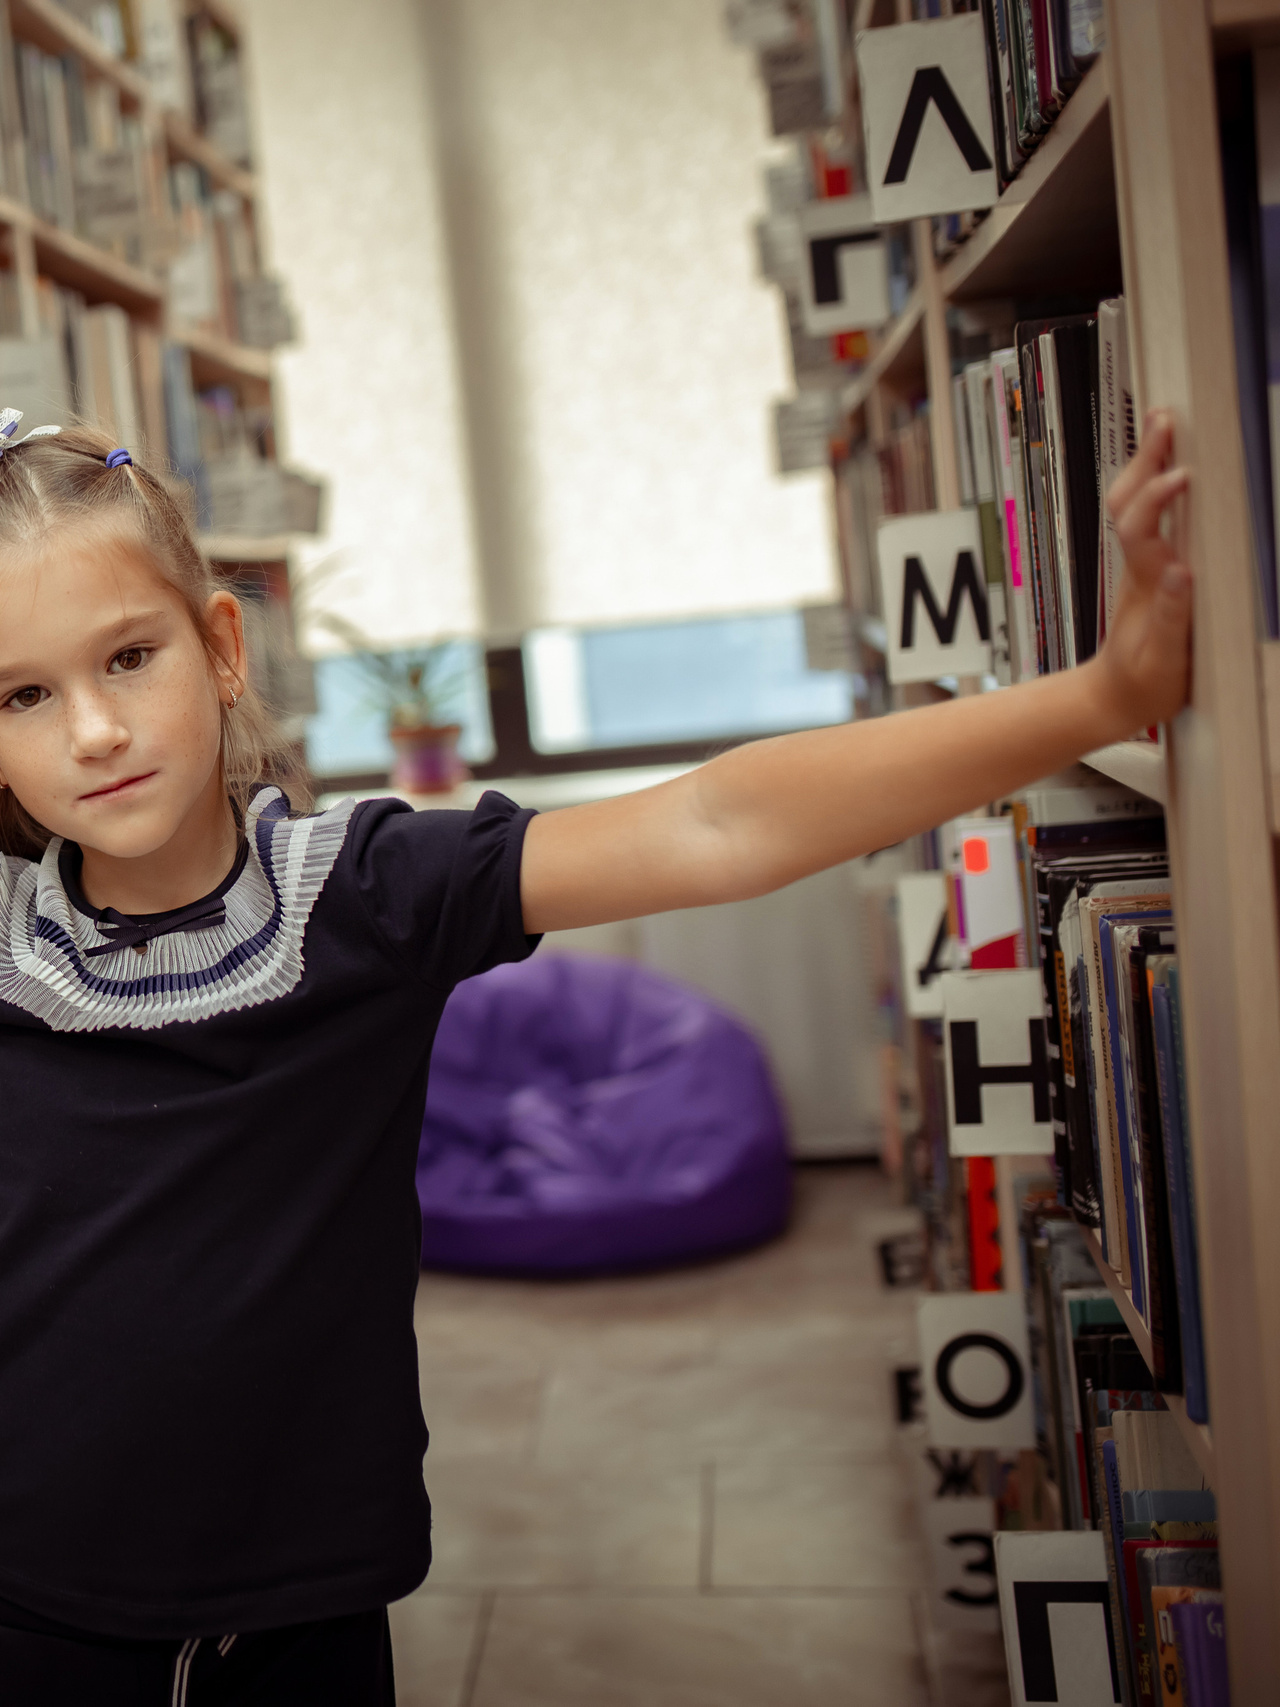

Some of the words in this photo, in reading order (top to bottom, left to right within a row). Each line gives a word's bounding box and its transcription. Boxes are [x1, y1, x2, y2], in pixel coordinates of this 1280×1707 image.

[1103, 340, 1115, 406] собака
[900, 551, 993, 650] М
[949, 1018, 1053, 1124] Н
[935, 1330, 1026, 1423] О
[1013, 1581, 1122, 1705] П
